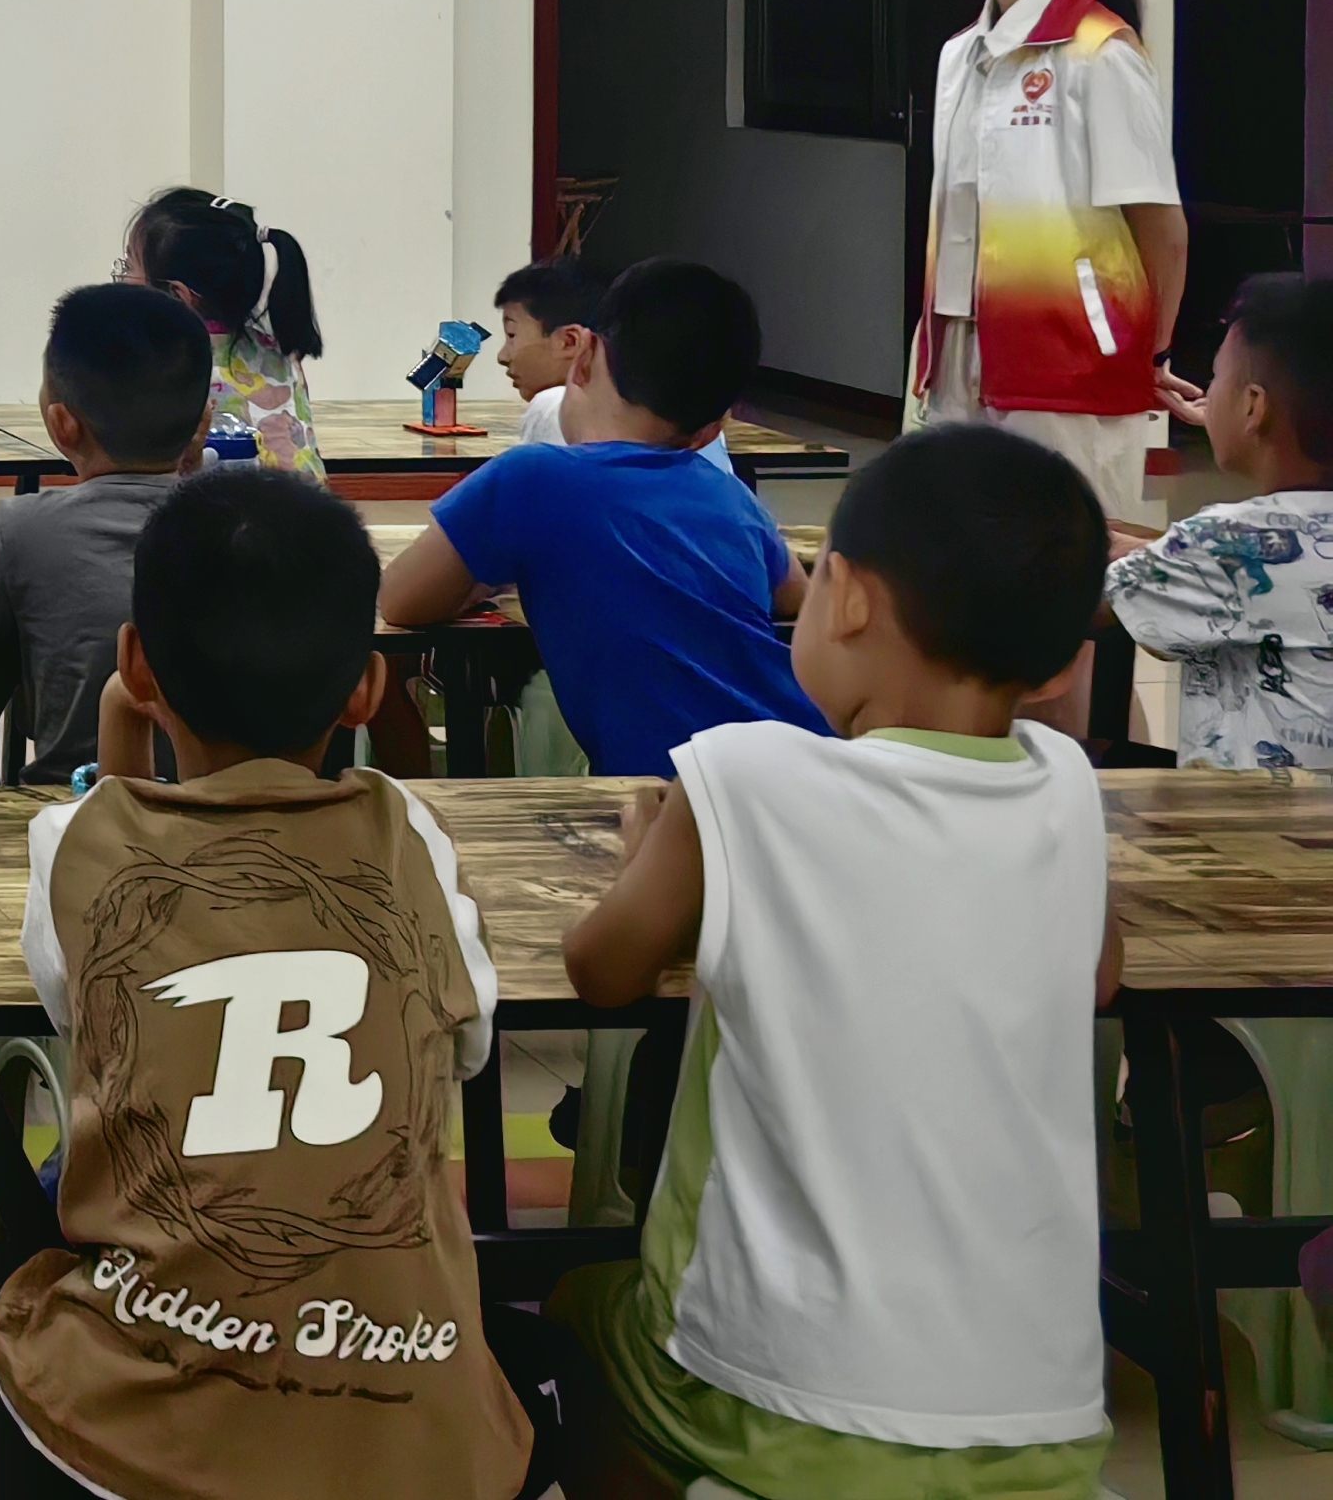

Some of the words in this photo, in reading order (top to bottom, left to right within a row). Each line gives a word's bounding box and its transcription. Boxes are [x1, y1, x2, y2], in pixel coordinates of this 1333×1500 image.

[140, 949, 383, 1157] R
[93, 1247, 277, 1355] Hidden
[294, 1298, 460, 1363] Stroke
